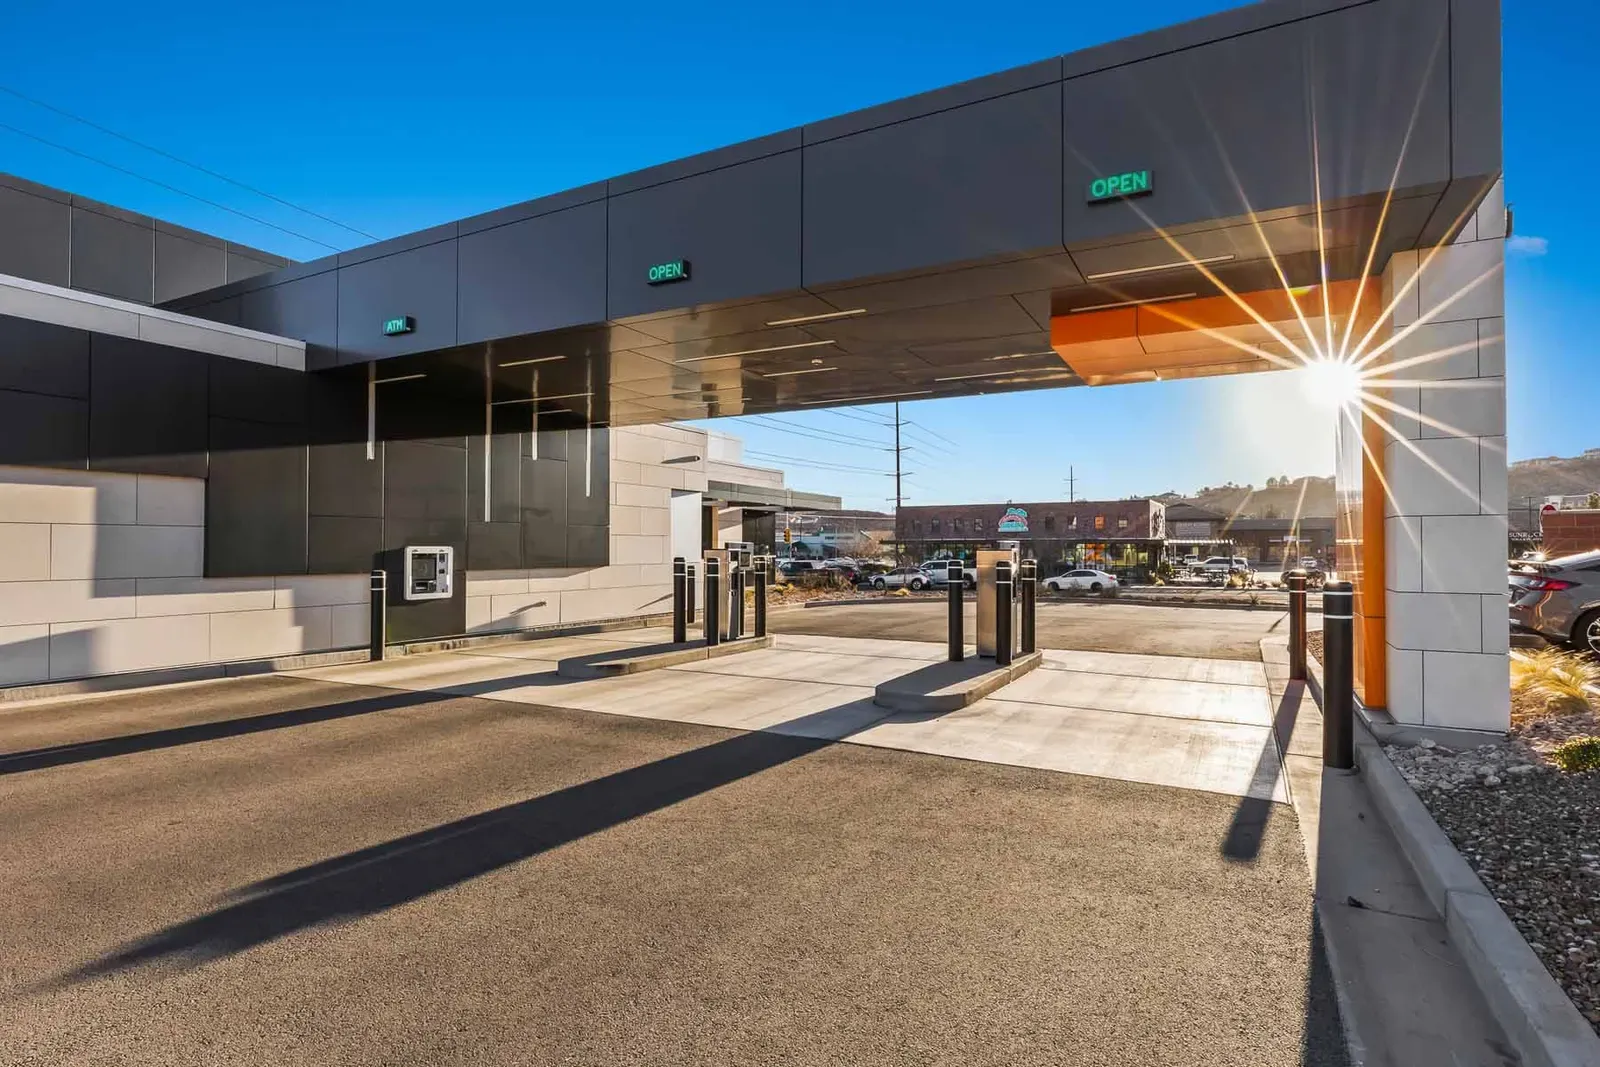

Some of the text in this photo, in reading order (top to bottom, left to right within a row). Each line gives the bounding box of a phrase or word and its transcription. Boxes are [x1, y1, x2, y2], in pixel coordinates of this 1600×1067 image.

[1091, 170, 1147, 198] OPEN
[649, 262, 681, 280] OPEN
[386, 319, 403, 333] ATM
